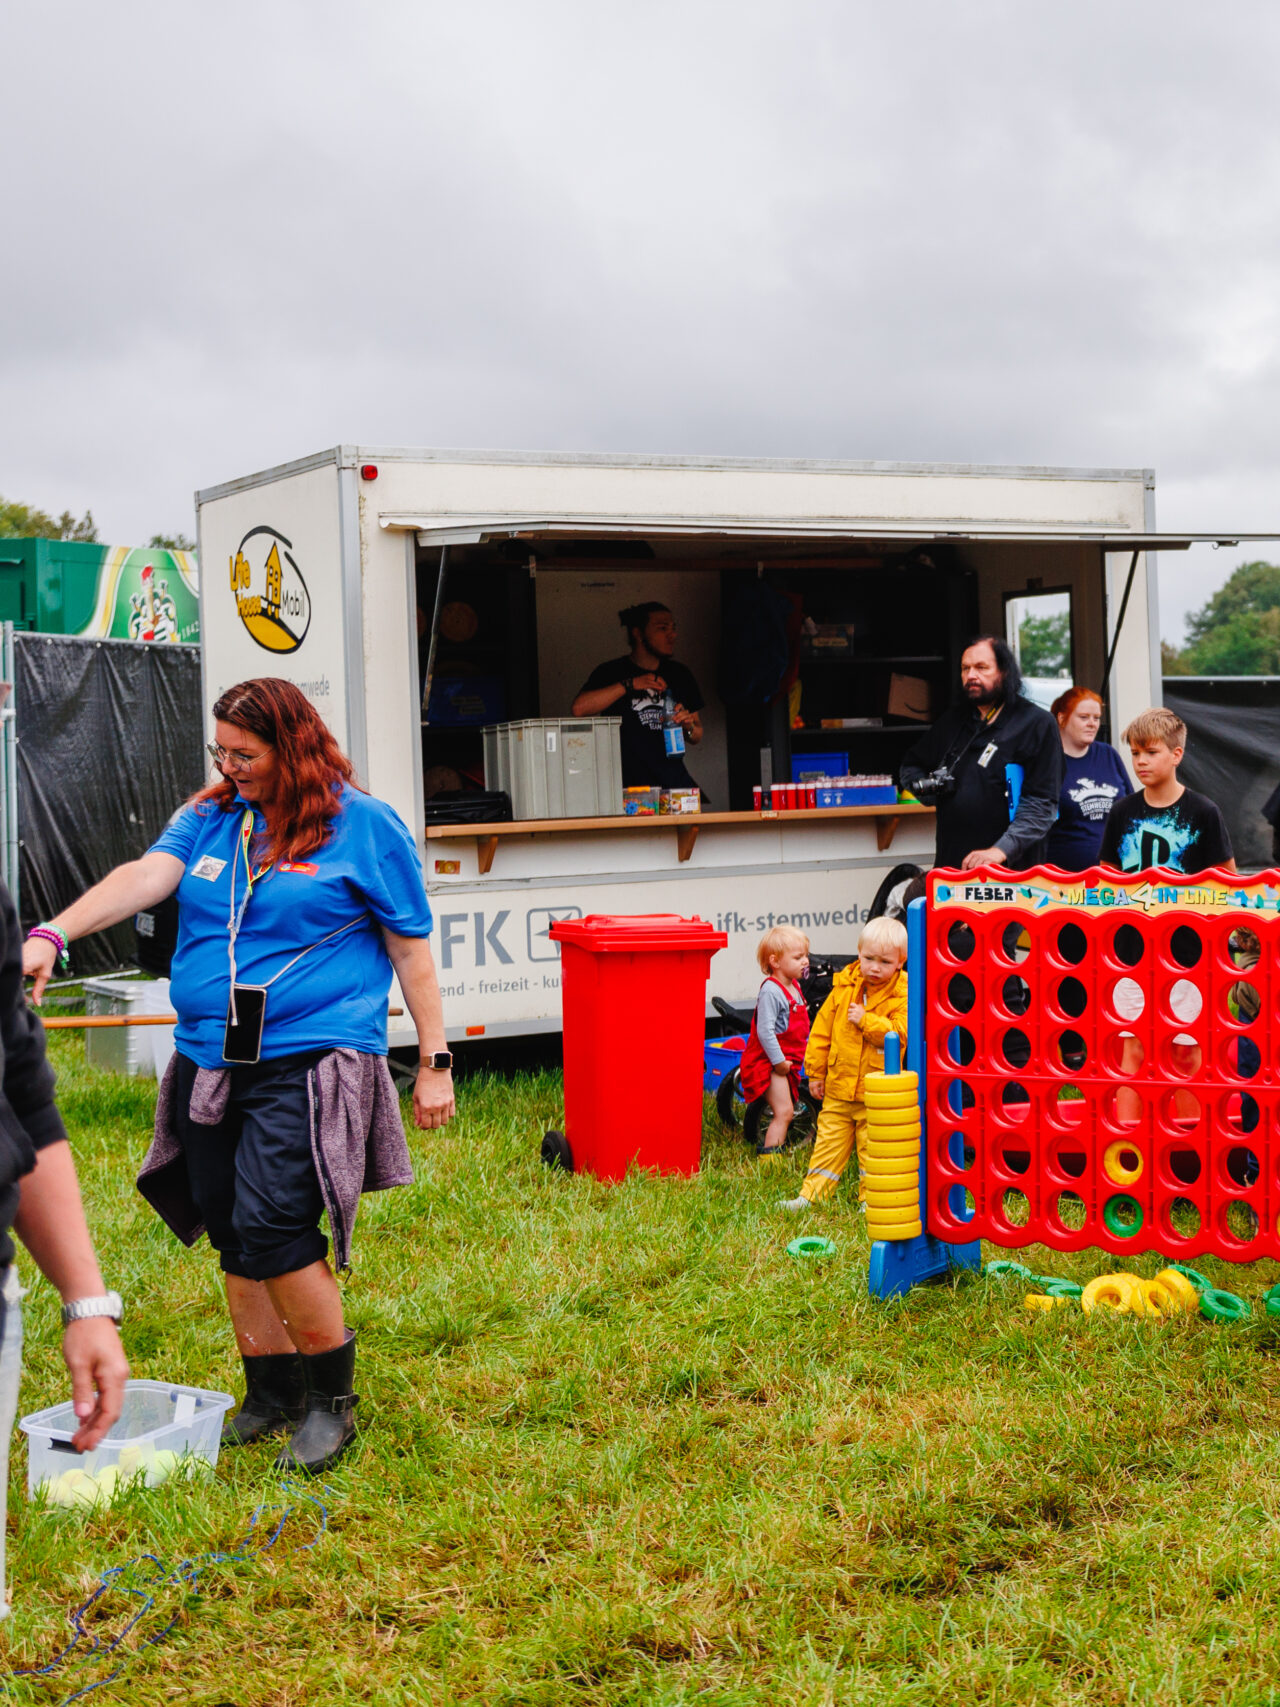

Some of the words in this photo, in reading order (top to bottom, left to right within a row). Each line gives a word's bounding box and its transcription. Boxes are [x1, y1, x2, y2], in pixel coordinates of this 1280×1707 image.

[281, 589, 305, 617] Mobil
[965, 887, 1014, 901] FEBER
[1067, 887, 1130, 906] MEGA
[1130, 881, 1155, 911] 4
[1157, 887, 1178, 904] IN
[1184, 888, 1228, 906] LINE
[439, 910, 515, 969] FK
[479, 977, 529, 994] freizeit
